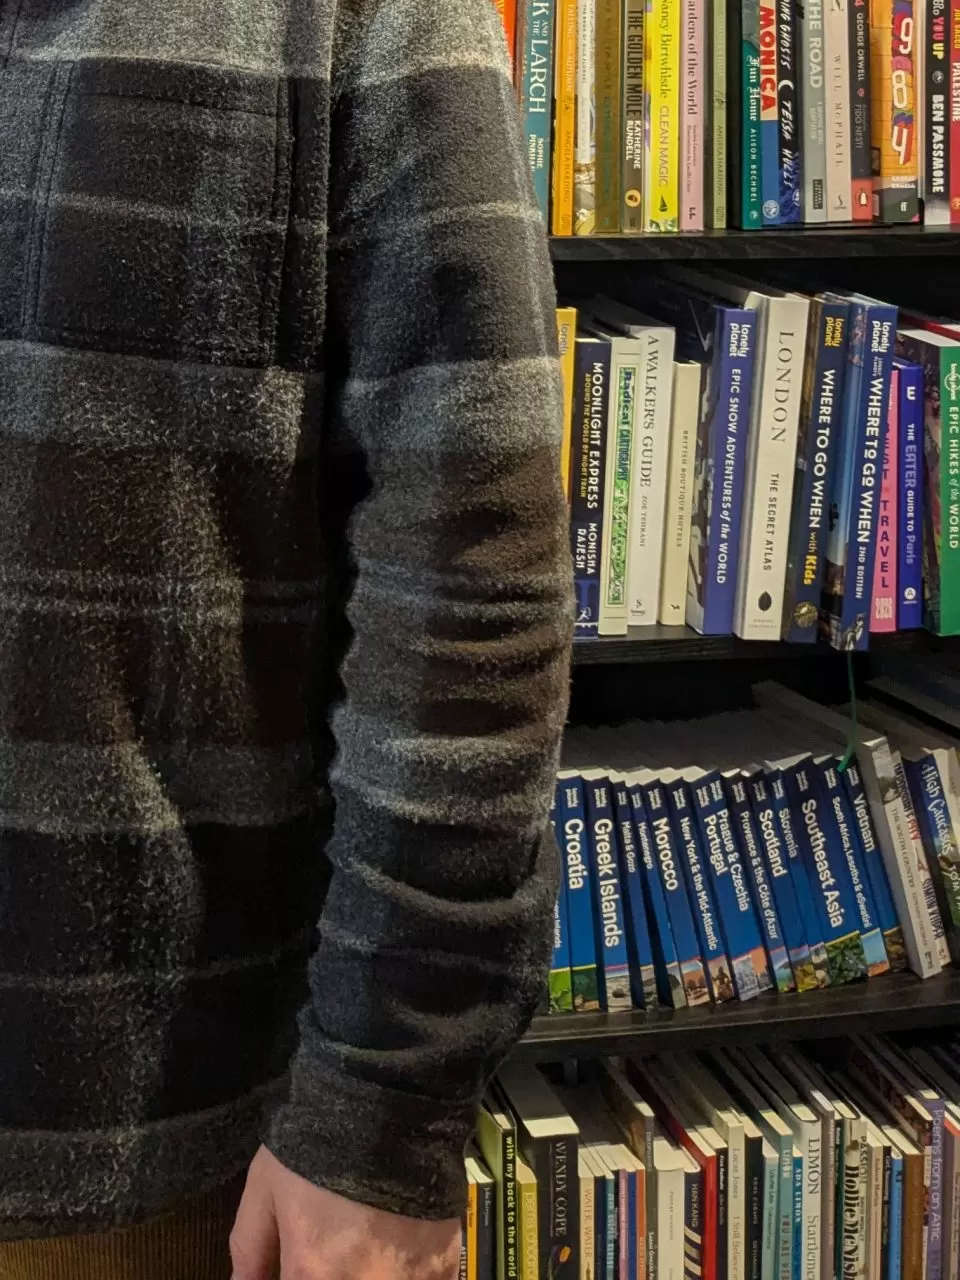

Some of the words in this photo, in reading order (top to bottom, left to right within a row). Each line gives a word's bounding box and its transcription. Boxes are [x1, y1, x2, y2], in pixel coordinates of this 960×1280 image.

[628, 9, 643, 32] THE
[529, 40, 548, 112] LARCH
[627, 35, 643, 78] GOLDEN
[759, 5, 777, 112] MONICA
[809, 37, 822, 88] ROAD
[626, 82, 642, 117] MOLE
[625, 120, 633, 160] RUNDELL
[633, 120, 641, 170] KATHERINE
[590, 362, 603, 446] MOONLIGHT
[771, 330, 794, 443] LONDON
[819, 369, 835, 426] WHERE
[814, 452, 828, 476] GO
[816, 429, 830, 449] TO
[588, 449, 602, 509] EXPRESS
[809, 480, 825, 528] WHEN
[594, 818, 616, 876] Greek
[703, 816, 730, 876] Portugal
[759, 809, 787, 878] Scotland
[853, 795, 875, 852] Vietnam
[565, 818, 588, 889] Croatia
[652, 817, 678, 890] Morocco
[801, 799, 836, 887] Southeast
[824, 888, 844, 928] Asia
[600, 878, 623, 947] Islands
[505, 1164, 514, 1178] my
[506, 1136, 514, 1156] with
[556, 1142, 566, 1192] WENDY
[806, 1137, 820, 1195] LIMON
[508, 1212, 515, 1222] to
[508, 1226, 516, 1244] the
[555, 1197, 567, 1236] COPE
[508, 1248, 516, 1277] world
